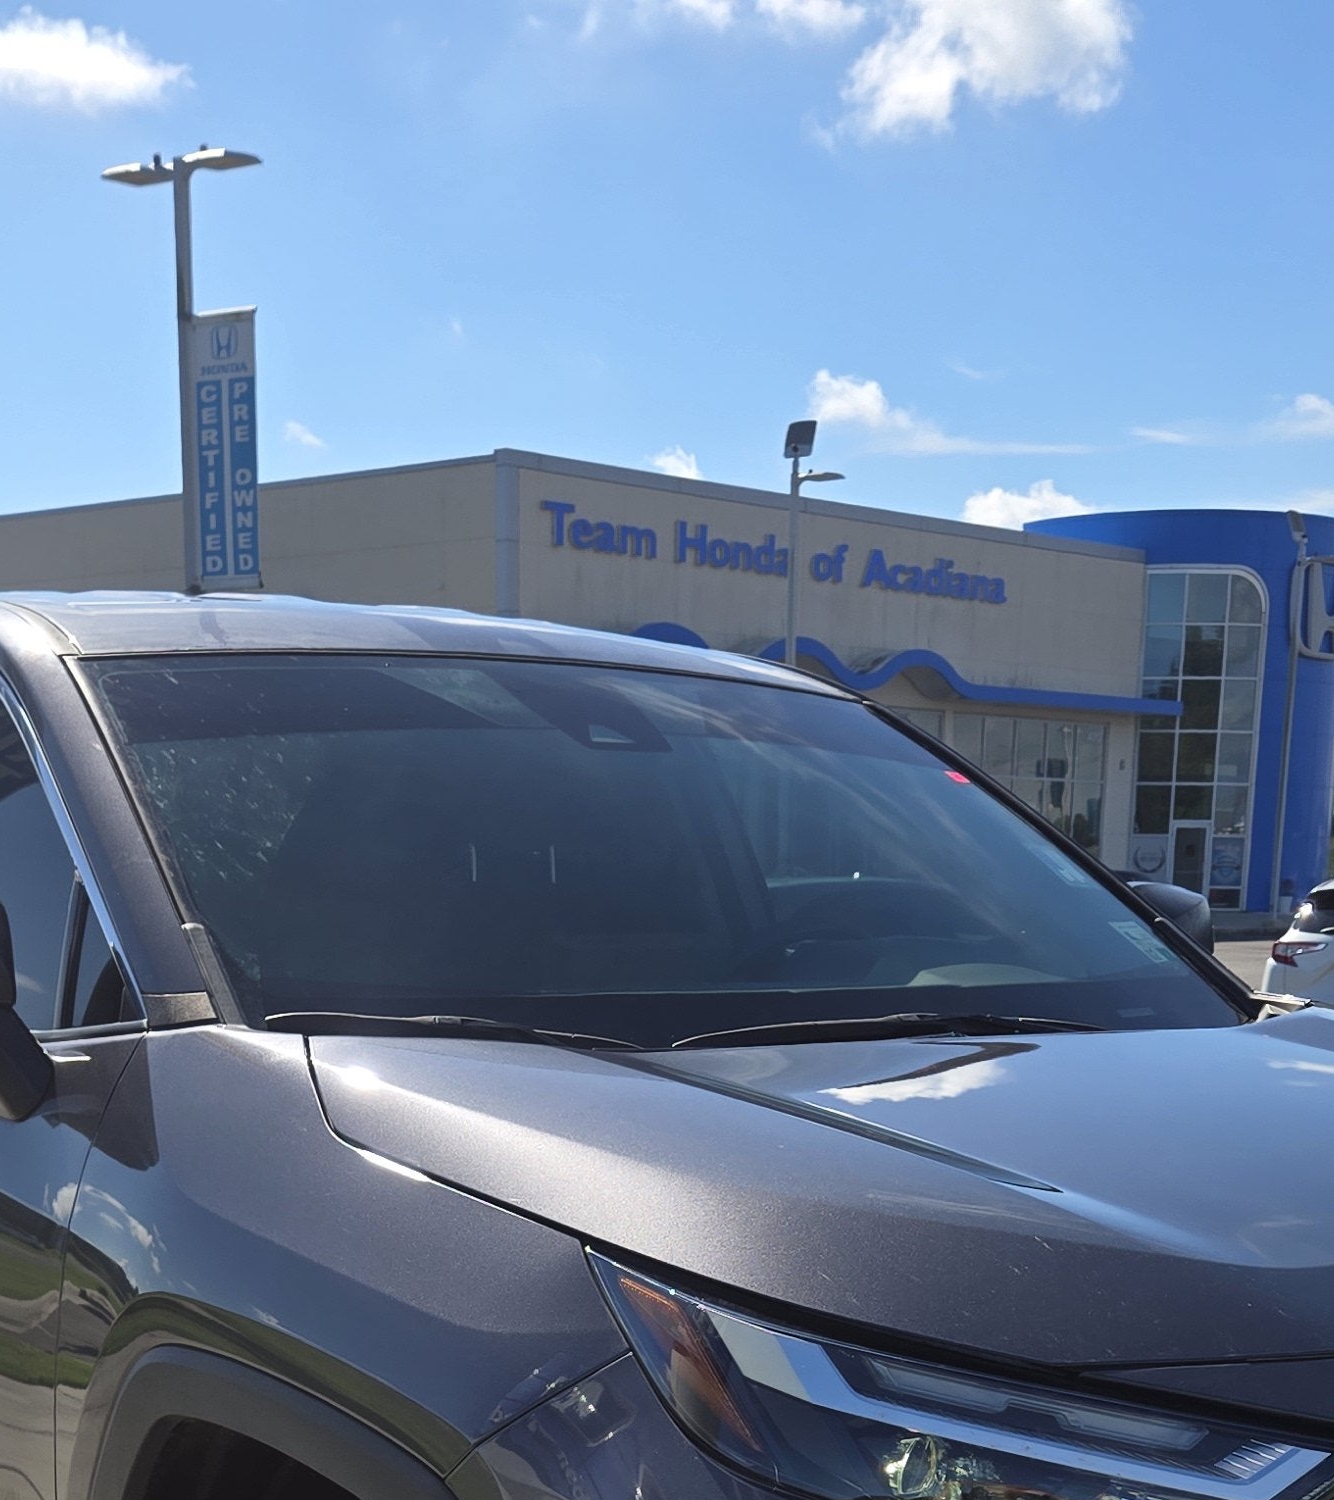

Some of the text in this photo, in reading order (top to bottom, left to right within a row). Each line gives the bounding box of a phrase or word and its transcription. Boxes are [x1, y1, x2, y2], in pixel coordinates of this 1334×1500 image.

[200, 362, 248, 376] HONDA
[200, 384, 224, 573] CERTIFIED
[233, 381, 254, 571] PRE OWNED
[542, 501, 1008, 604] Team Honda of Acadiana
